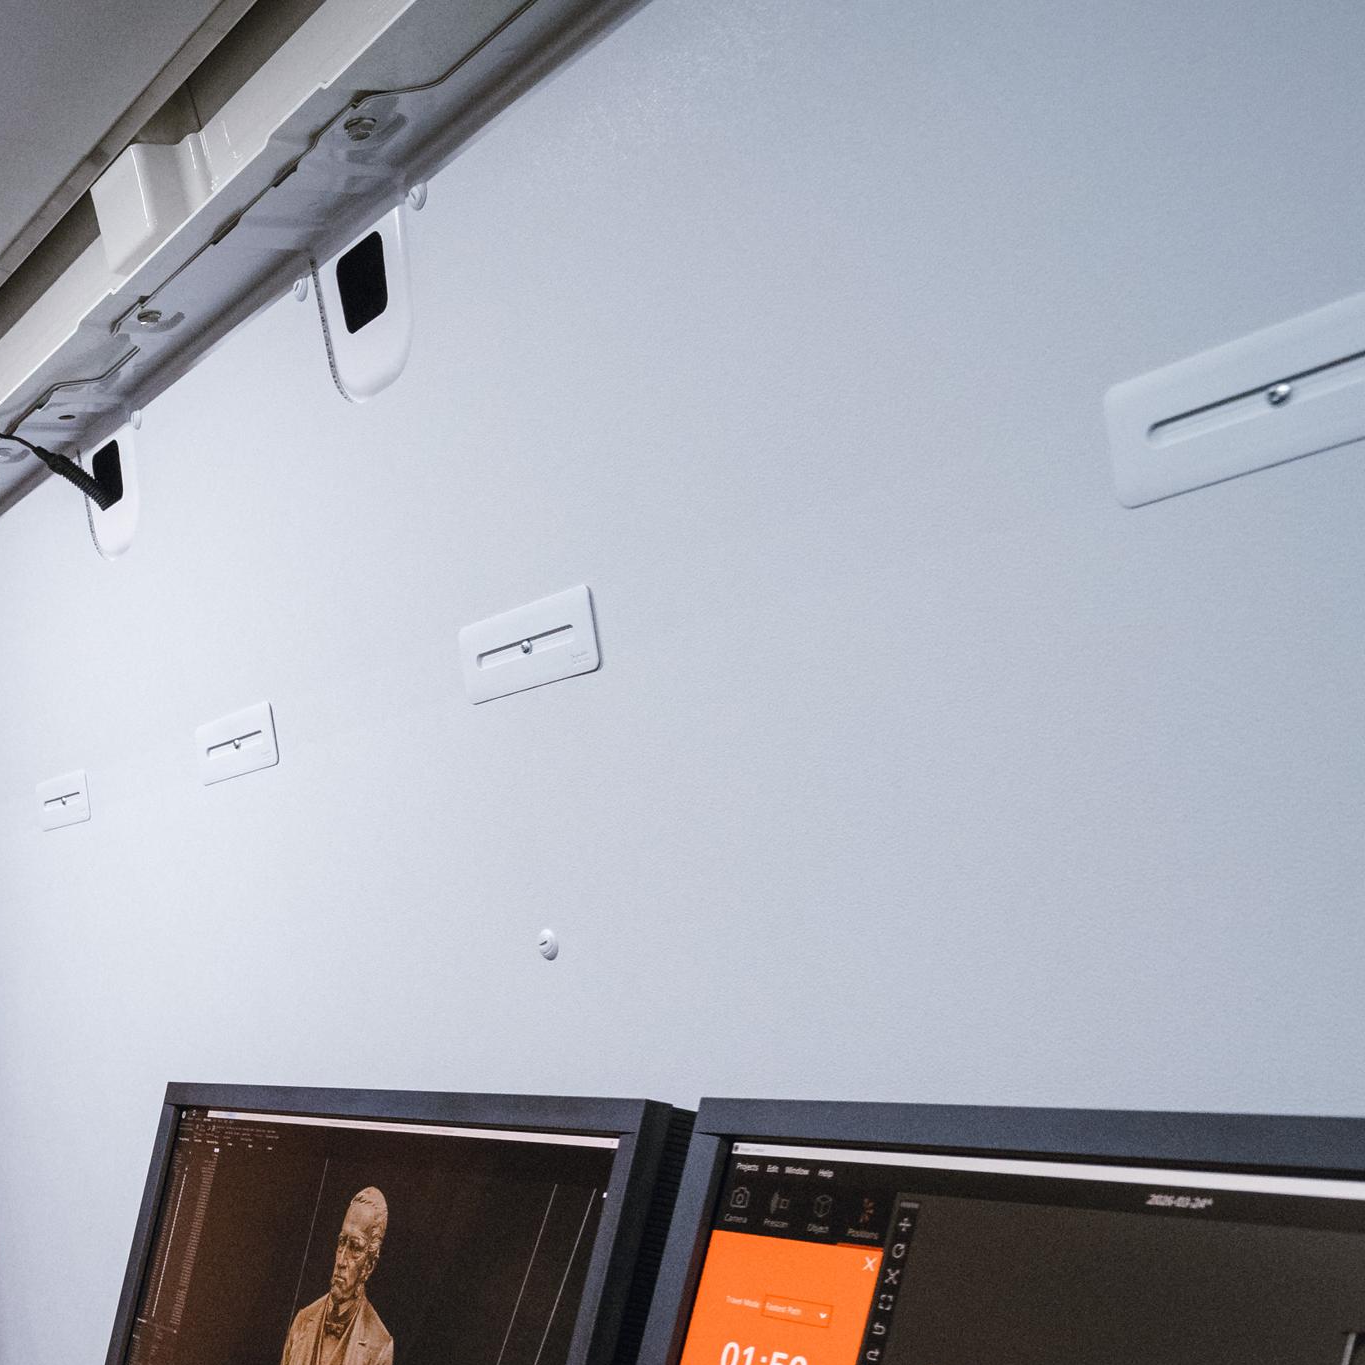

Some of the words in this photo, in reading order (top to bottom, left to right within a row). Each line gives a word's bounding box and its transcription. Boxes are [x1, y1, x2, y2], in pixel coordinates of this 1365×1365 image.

[736, 1162, 759, 1173] Projects
[766, 1164, 779, 1173] Edit
[785, 1165, 810, 1176] Window
[818, 1168, 834, 1179] Help
[724, 1213, 748, 1224] Camera
